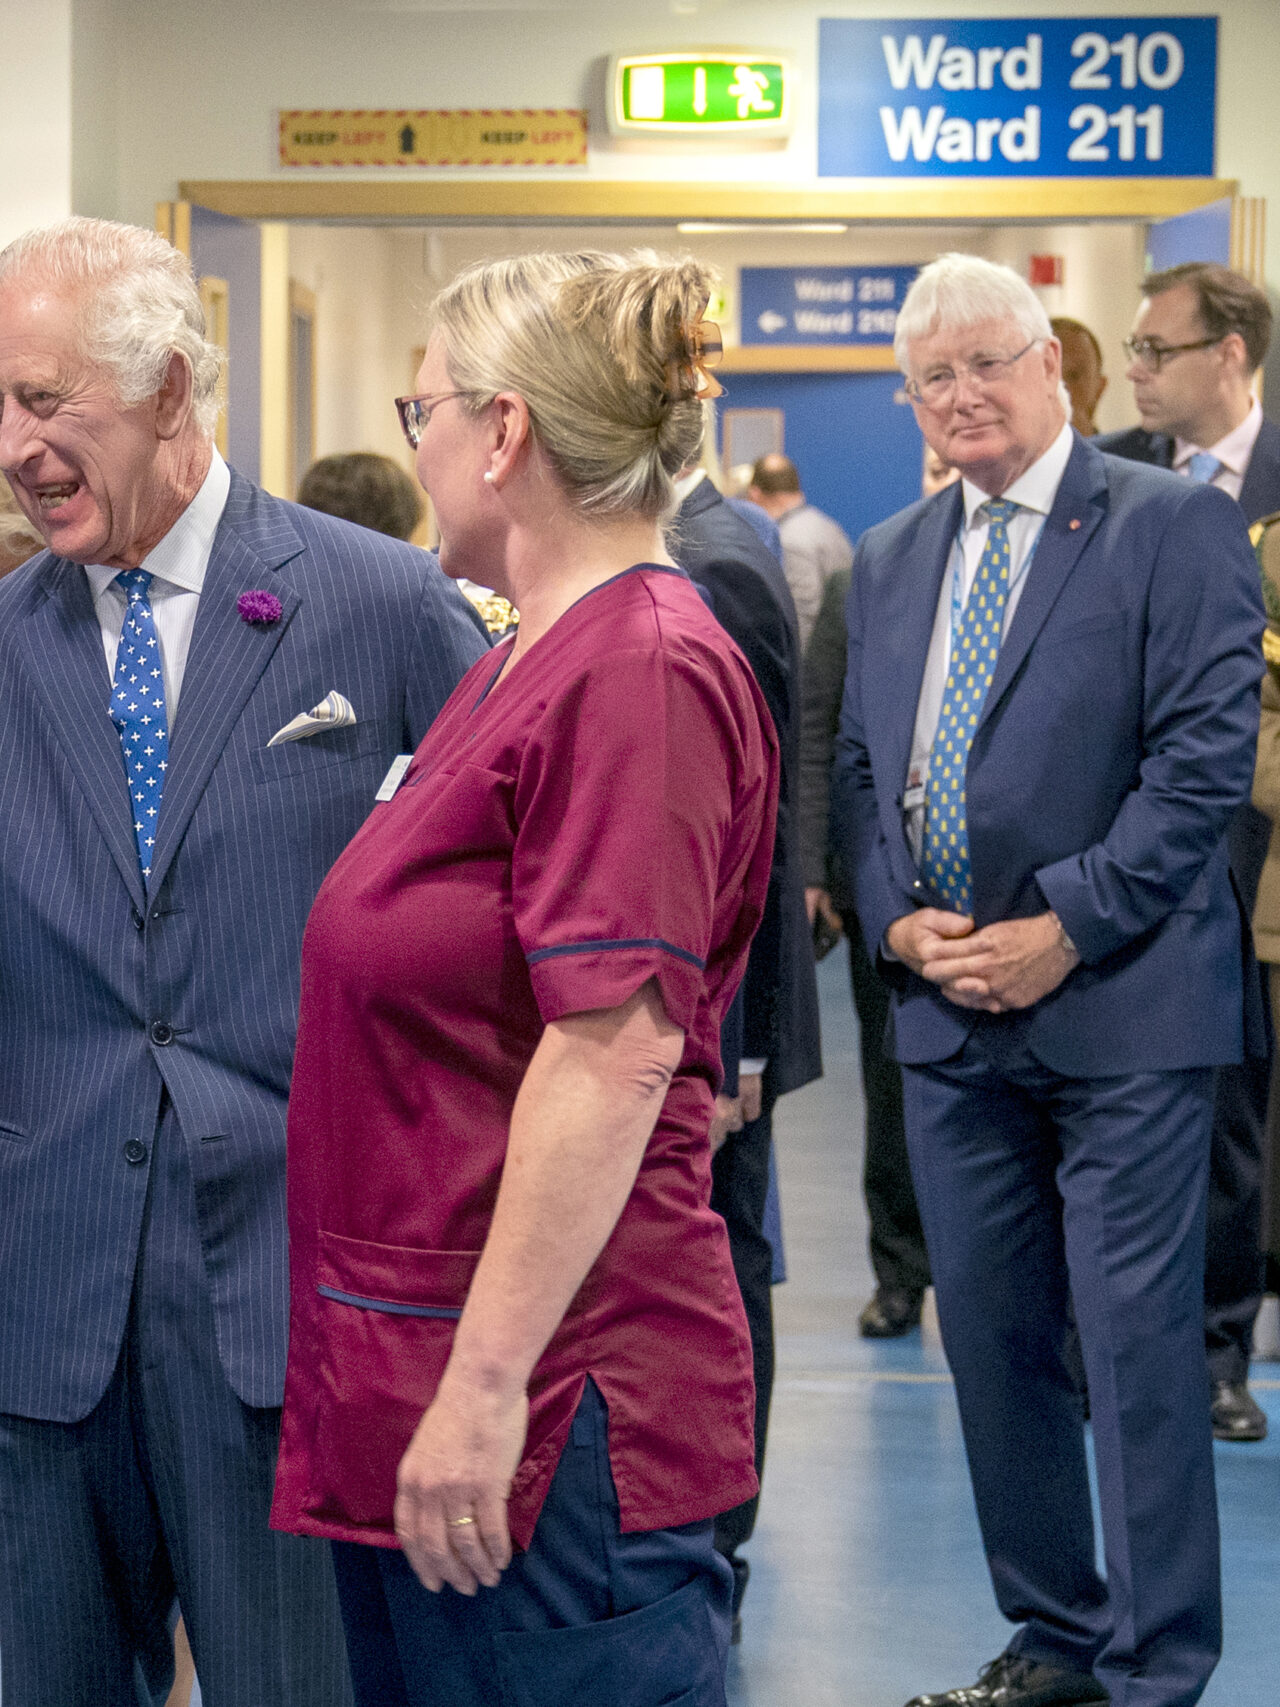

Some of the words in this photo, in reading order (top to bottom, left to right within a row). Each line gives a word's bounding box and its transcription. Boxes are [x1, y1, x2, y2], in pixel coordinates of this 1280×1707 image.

[881, 33, 1042, 90] Ward
[1069, 32, 1184, 90] 210
[293, 131, 338, 145] KEEP
[341, 131, 387, 145] LEFT
[481, 130, 528, 144] KEEP
[530, 130, 574, 144] LEFT
[879, 105, 1041, 162] Ward
[1067, 104, 1164, 162] 211
[794, 277, 855, 302] Ward
[858, 277, 895, 302] 211
[793, 309, 854, 334] Ward
